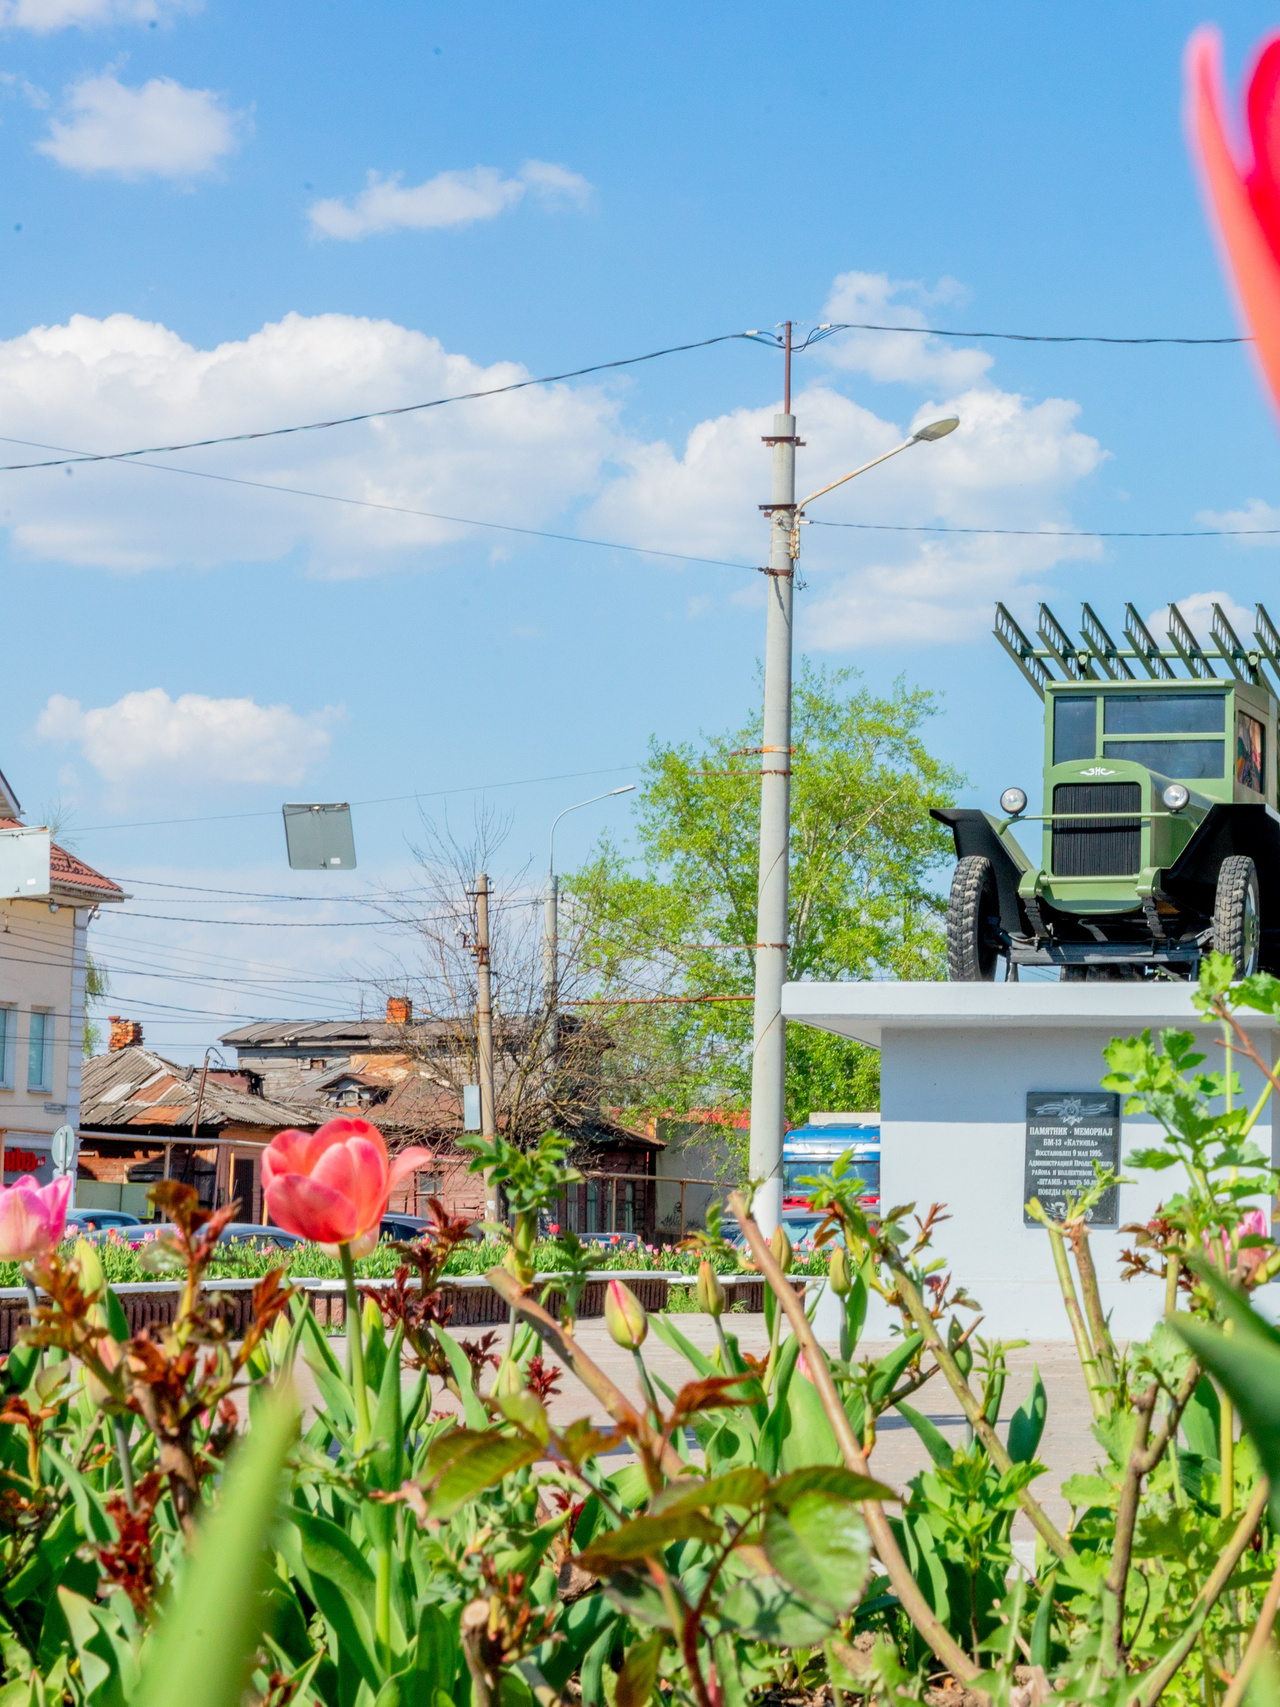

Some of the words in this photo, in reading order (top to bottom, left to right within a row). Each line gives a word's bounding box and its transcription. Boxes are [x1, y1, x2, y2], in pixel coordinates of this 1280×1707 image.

[1029, 1126, 1068, 1136] ПАМЯТНИК
[1074, 1127, 1113, 1136] МЕМОРИАЛ
[1043, 1138, 1062, 1146] БМ-13
